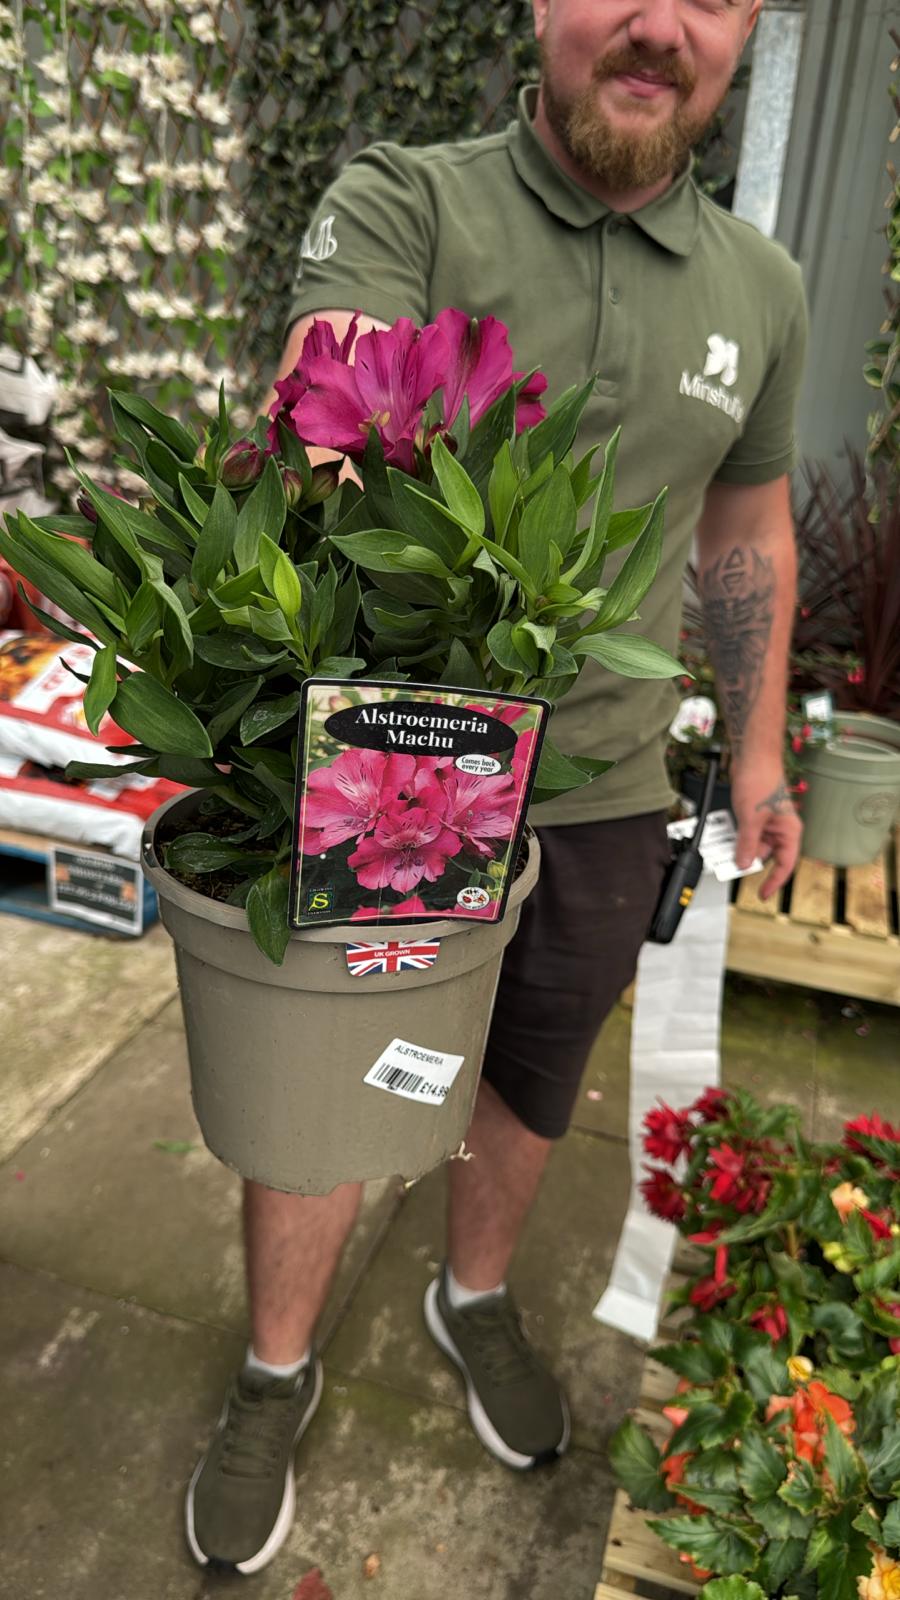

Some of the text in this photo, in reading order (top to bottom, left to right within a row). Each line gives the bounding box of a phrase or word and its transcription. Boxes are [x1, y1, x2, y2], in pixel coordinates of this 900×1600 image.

[355, 708, 488, 734] Alstroemeria
[386, 729, 454, 749] Machu
[461, 757, 496, 767] Comes back
[461, 764, 479, 772] every
[385, 949, 410, 957] GROWN
